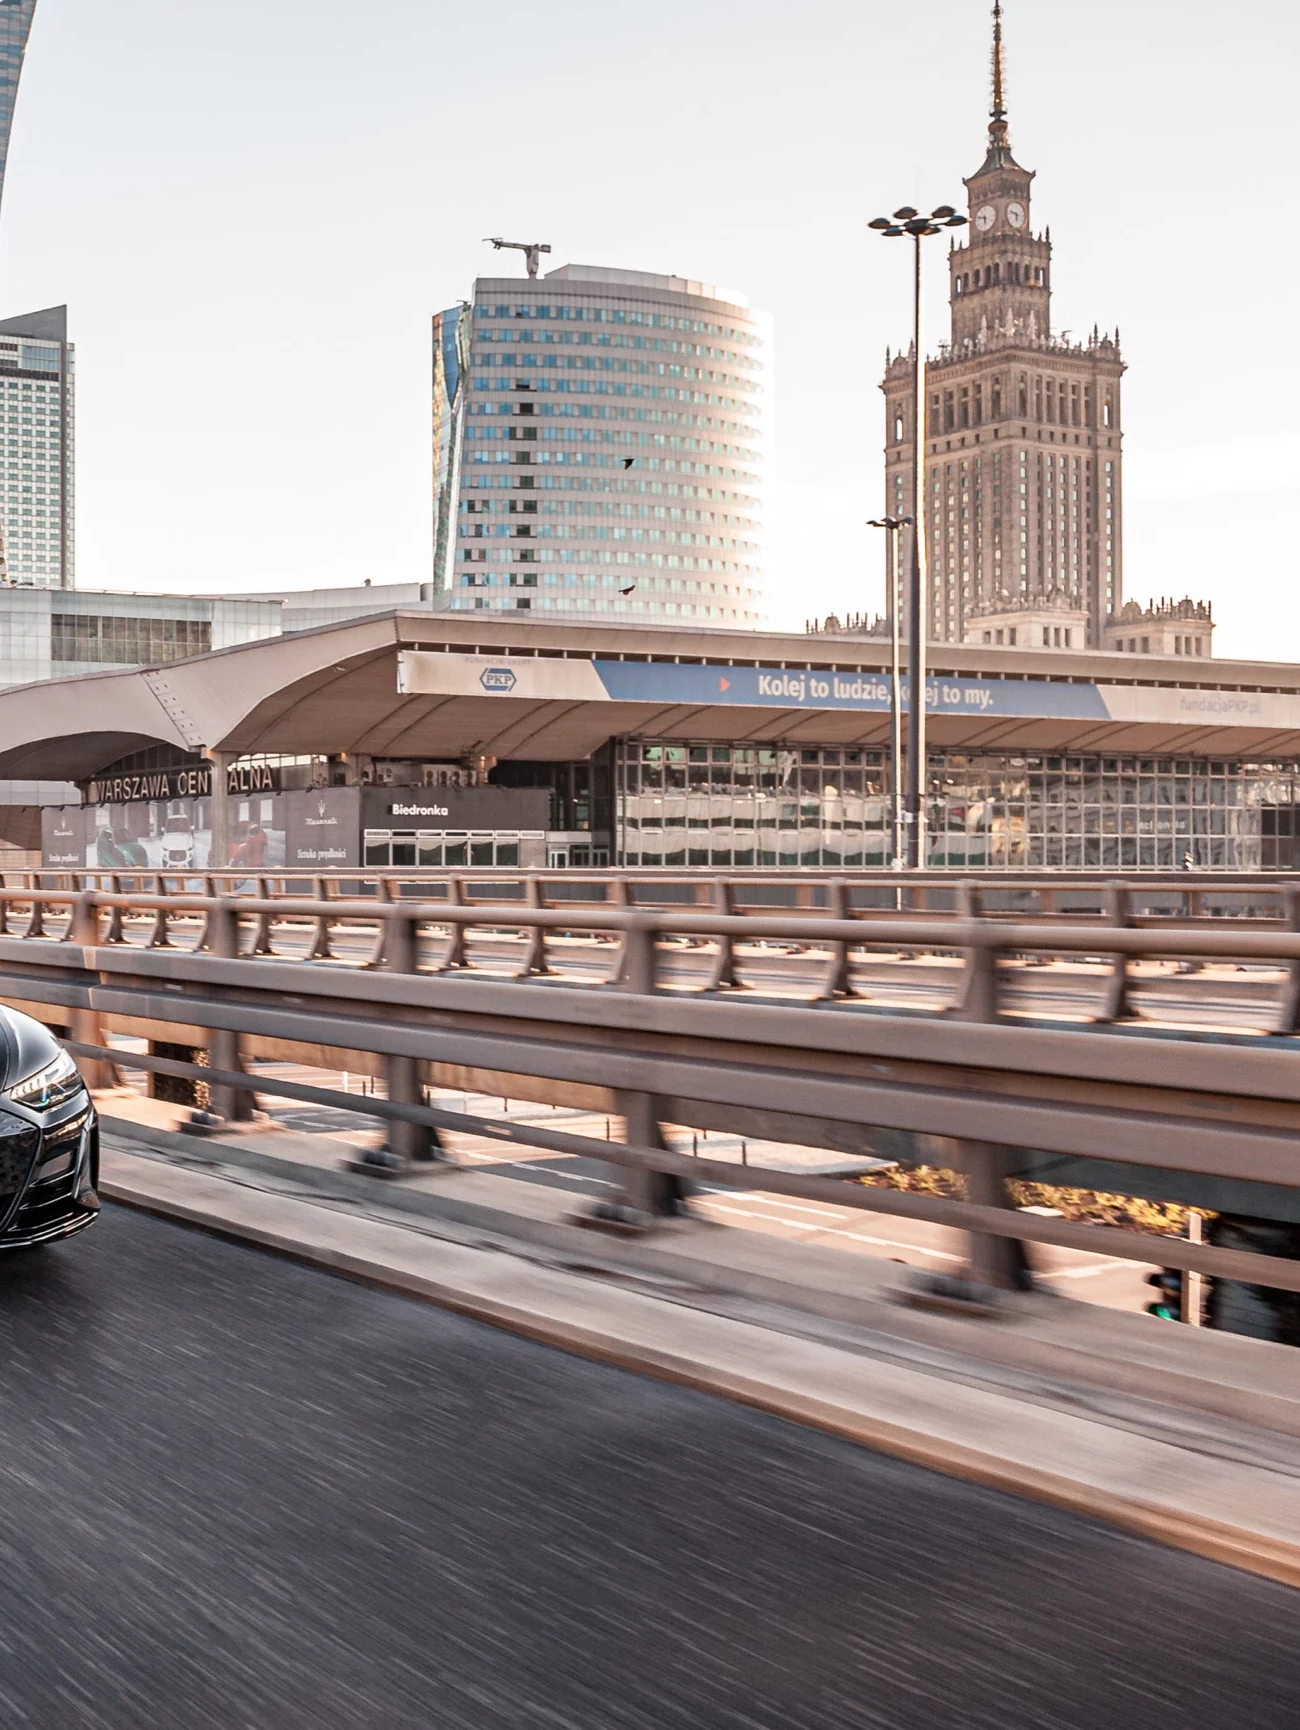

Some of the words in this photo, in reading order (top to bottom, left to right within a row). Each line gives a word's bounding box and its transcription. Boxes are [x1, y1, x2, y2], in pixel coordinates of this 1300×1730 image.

[486, 674, 512, 685] PKP
[758, 674, 805, 701] Kolej
[810, 678, 829, 698] to
[834, 676, 892, 704] ludzie,
[900, 680, 939, 703] kej
[943, 684, 961, 703] to
[965, 690, 994, 709] my.
[97, 773, 170, 801] WARSZAWA
[177, 764, 273, 795] CENALNA
[392, 803, 448, 816] Biedronka
